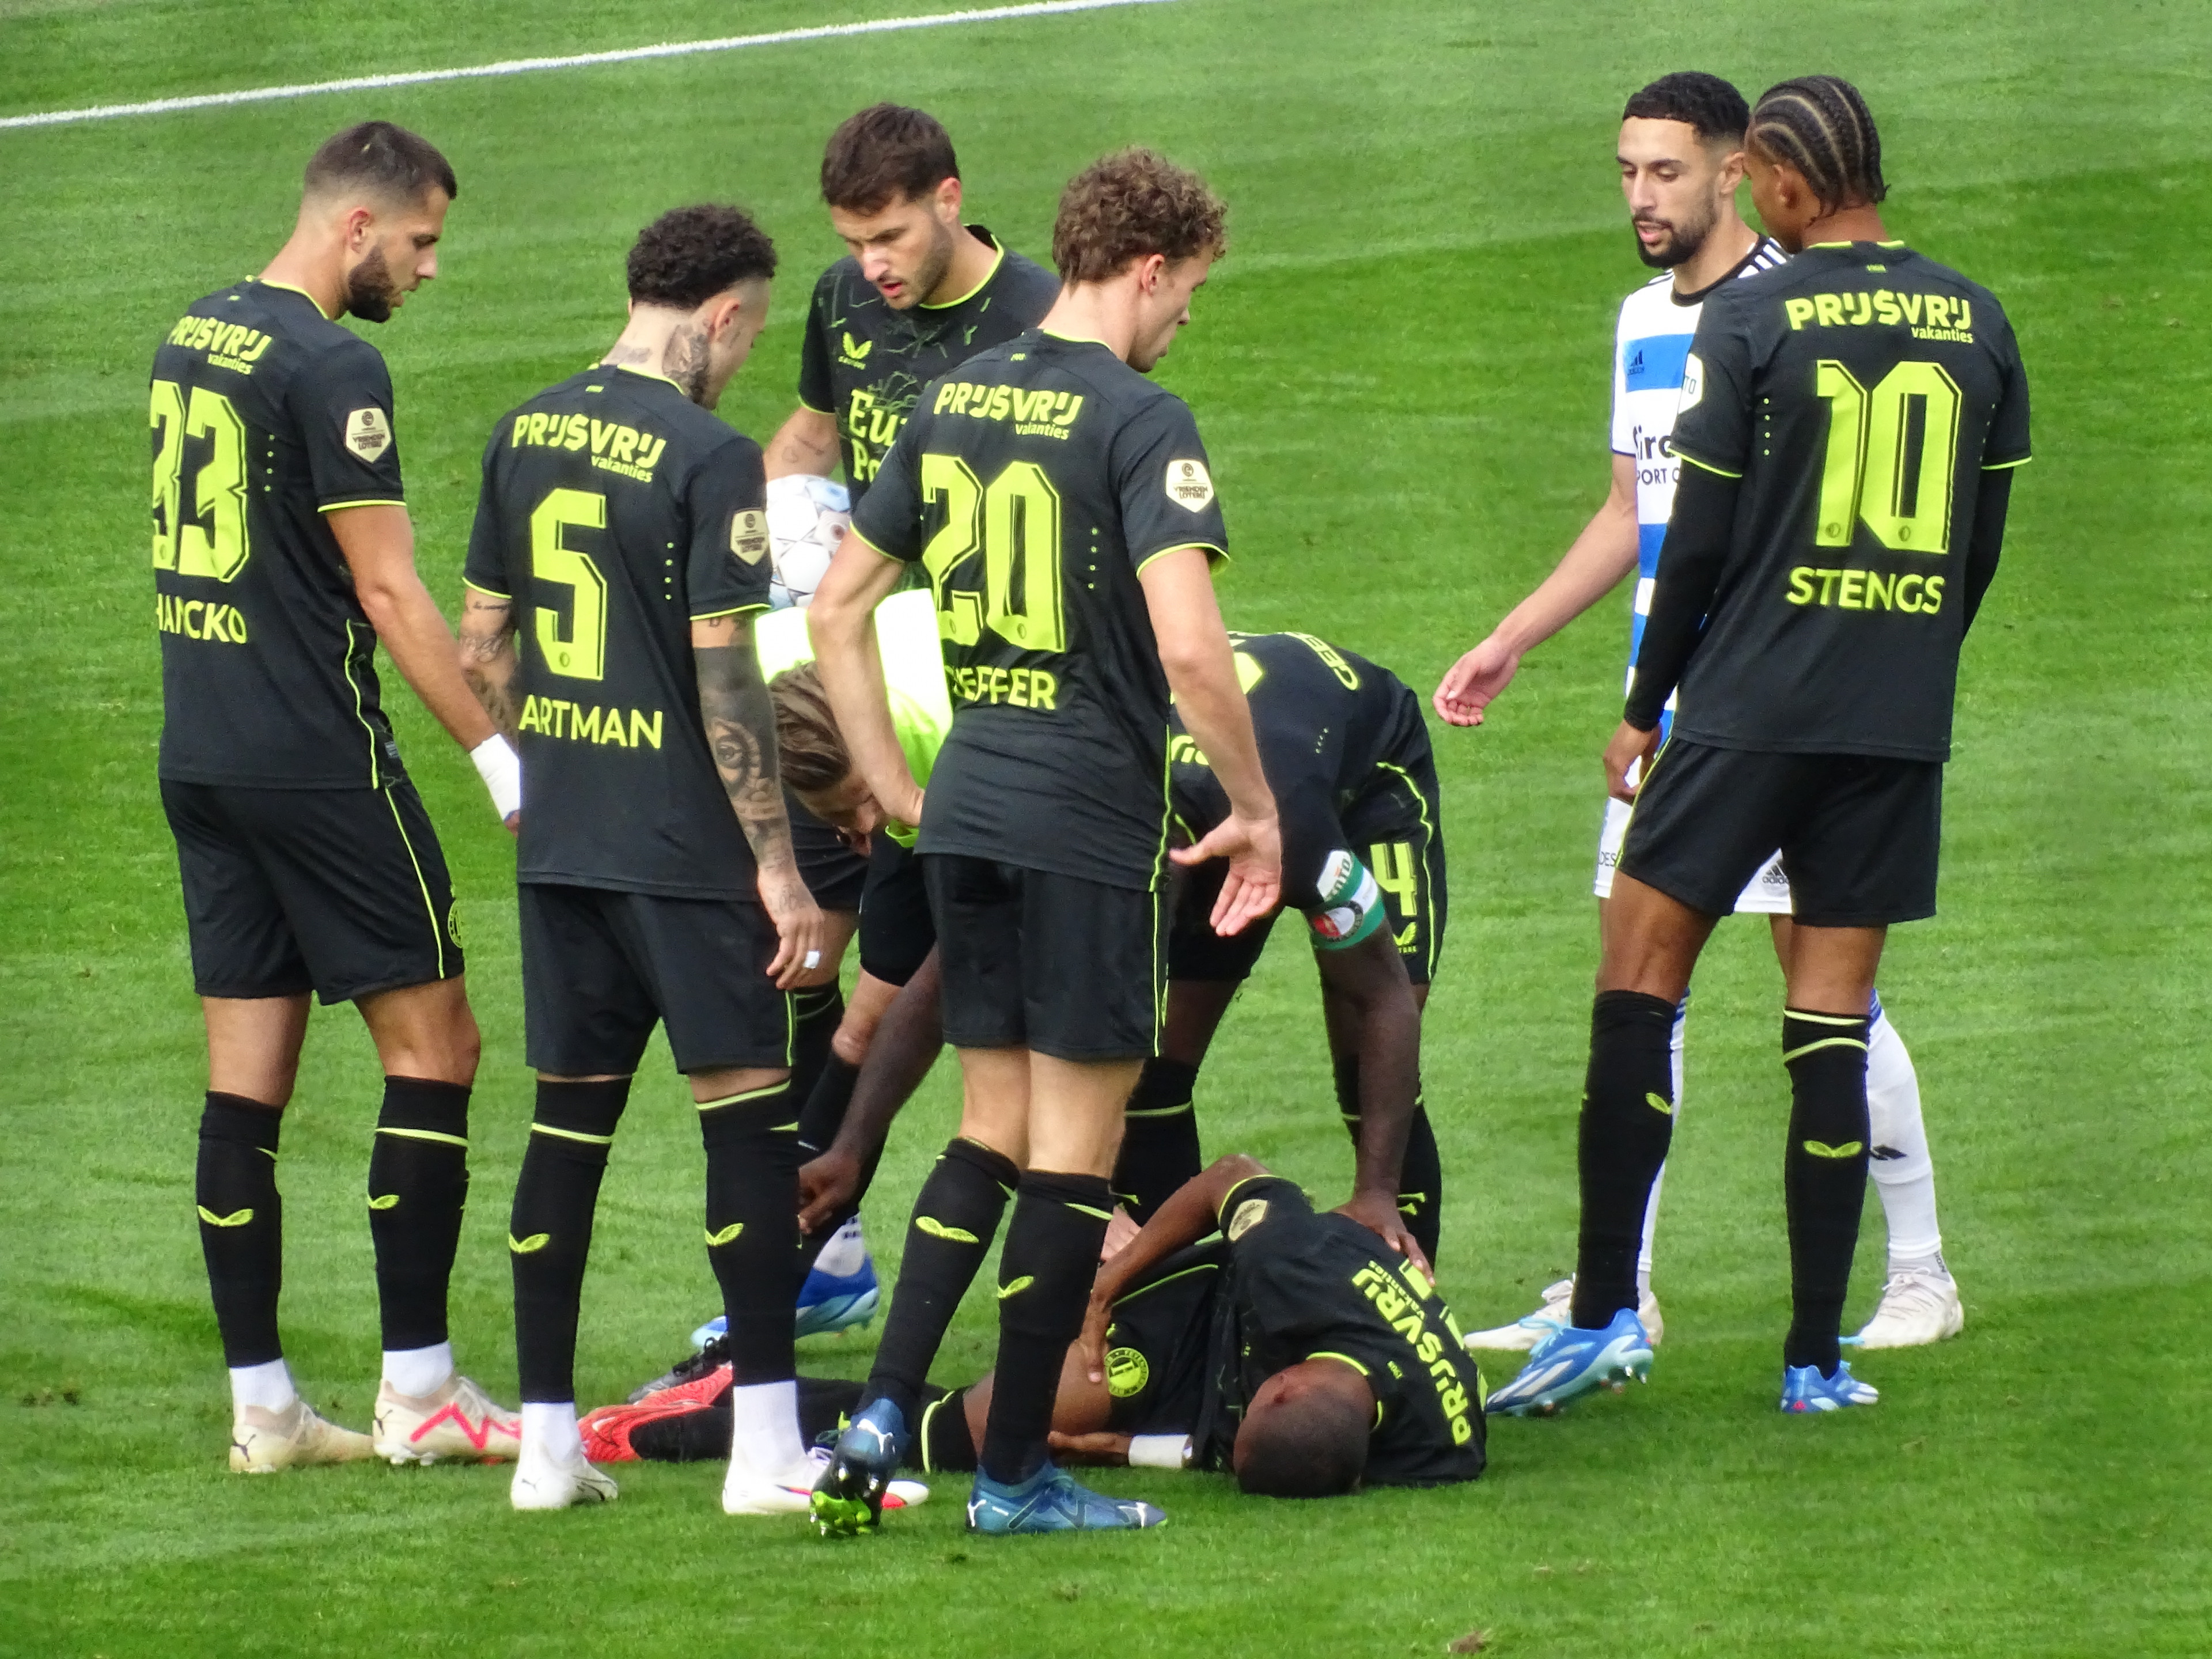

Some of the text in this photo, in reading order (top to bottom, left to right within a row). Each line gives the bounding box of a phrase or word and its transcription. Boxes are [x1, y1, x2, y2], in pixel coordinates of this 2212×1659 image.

[1785, 289, 1972, 331] PRIJSVRIJ
[1911, 326, 1974, 344] vakanties
[933, 382, 1084, 426] PRIJSVRIJ
[1014, 422, 1070, 441] vakanties
[512, 412, 667, 468] PRIJSVRIJ
[1816, 359, 1963, 555] 10
[150, 379, 249, 583] 33
[921, 453, 1066, 653] 20
[530, 488, 607, 681] 5
[1785, 566, 1945, 615] STENGS
[945, 665, 1056, 710] EFFER
[517, 694, 664, 750] ARTMAN
[1370, 842, 1418, 916] 4
